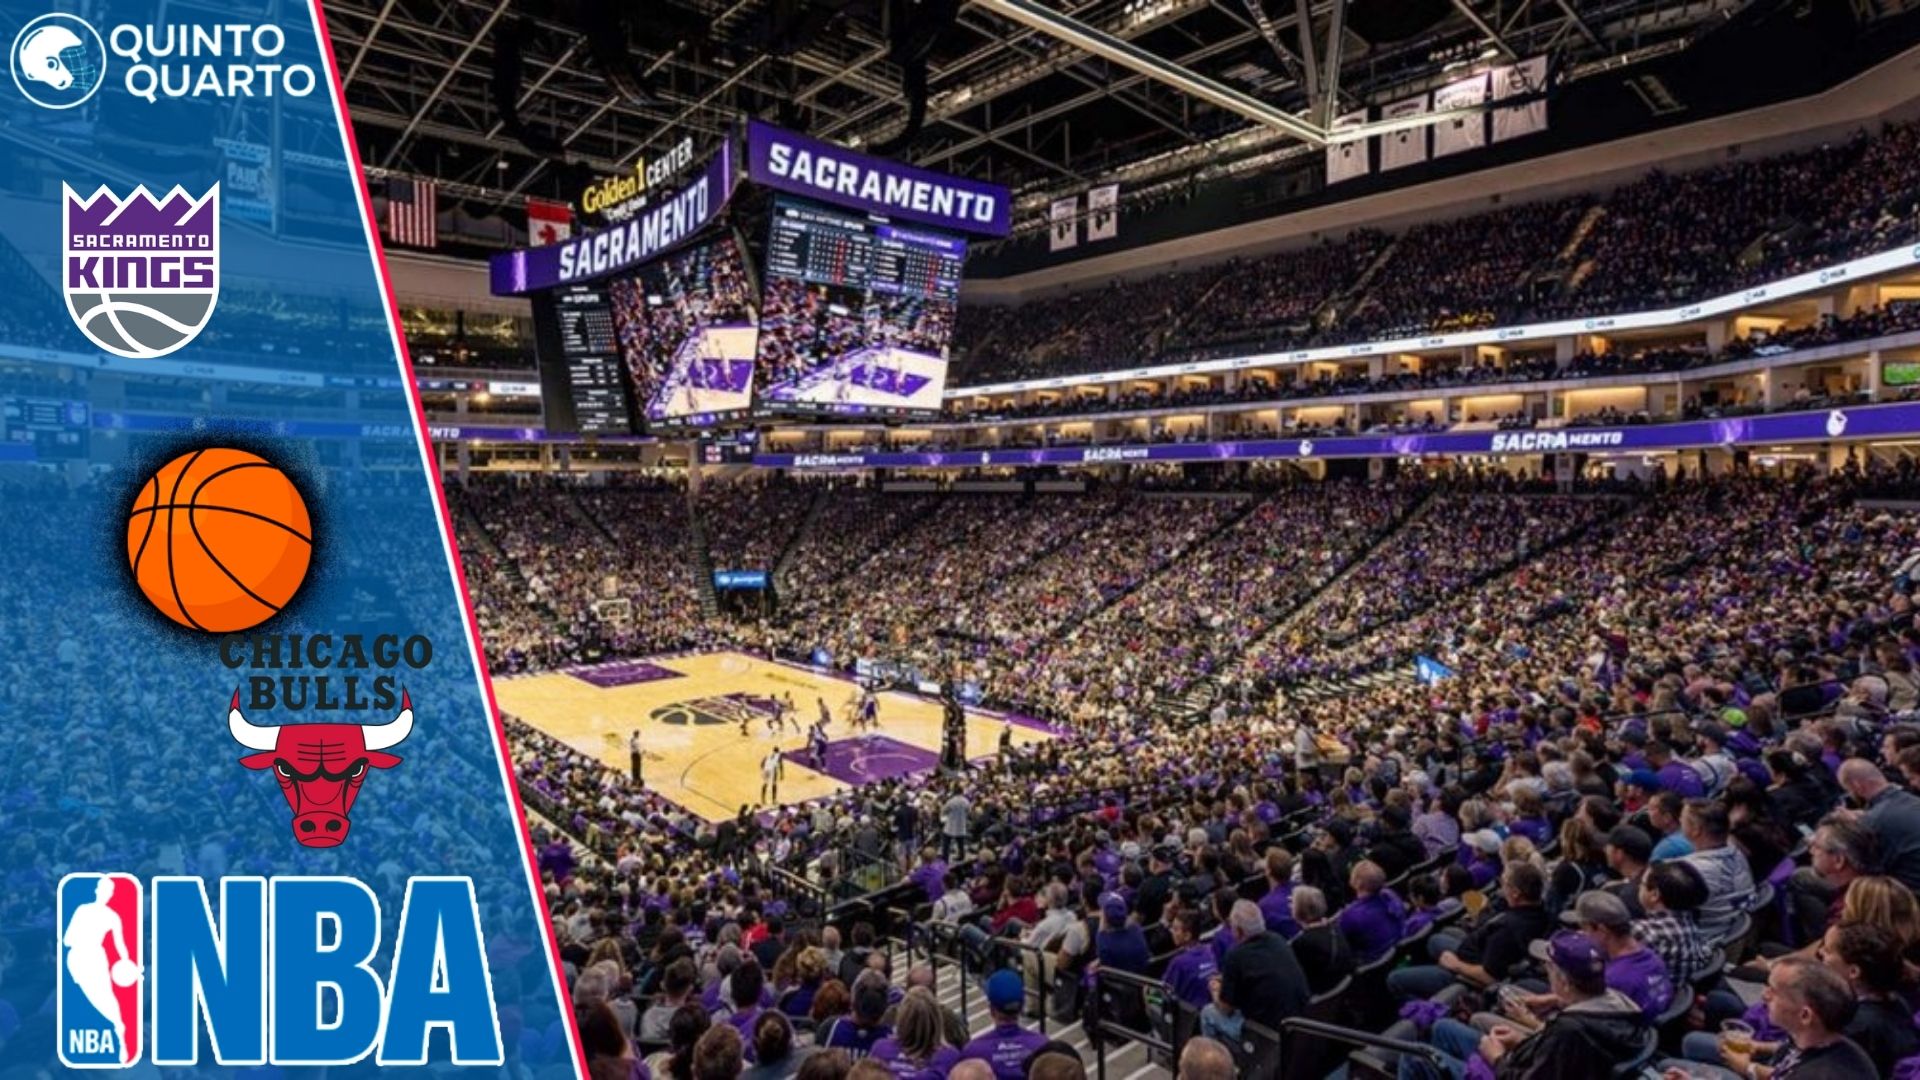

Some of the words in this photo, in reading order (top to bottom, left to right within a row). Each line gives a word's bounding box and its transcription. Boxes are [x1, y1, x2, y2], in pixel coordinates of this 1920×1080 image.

[583, 175, 636, 213] Golden
[636, 156, 646, 192] 1
[646, 137, 693, 187] CENTER
[768, 142, 995, 223] SACRAMENTO
[558, 176, 708, 280] SACRAMENTO
